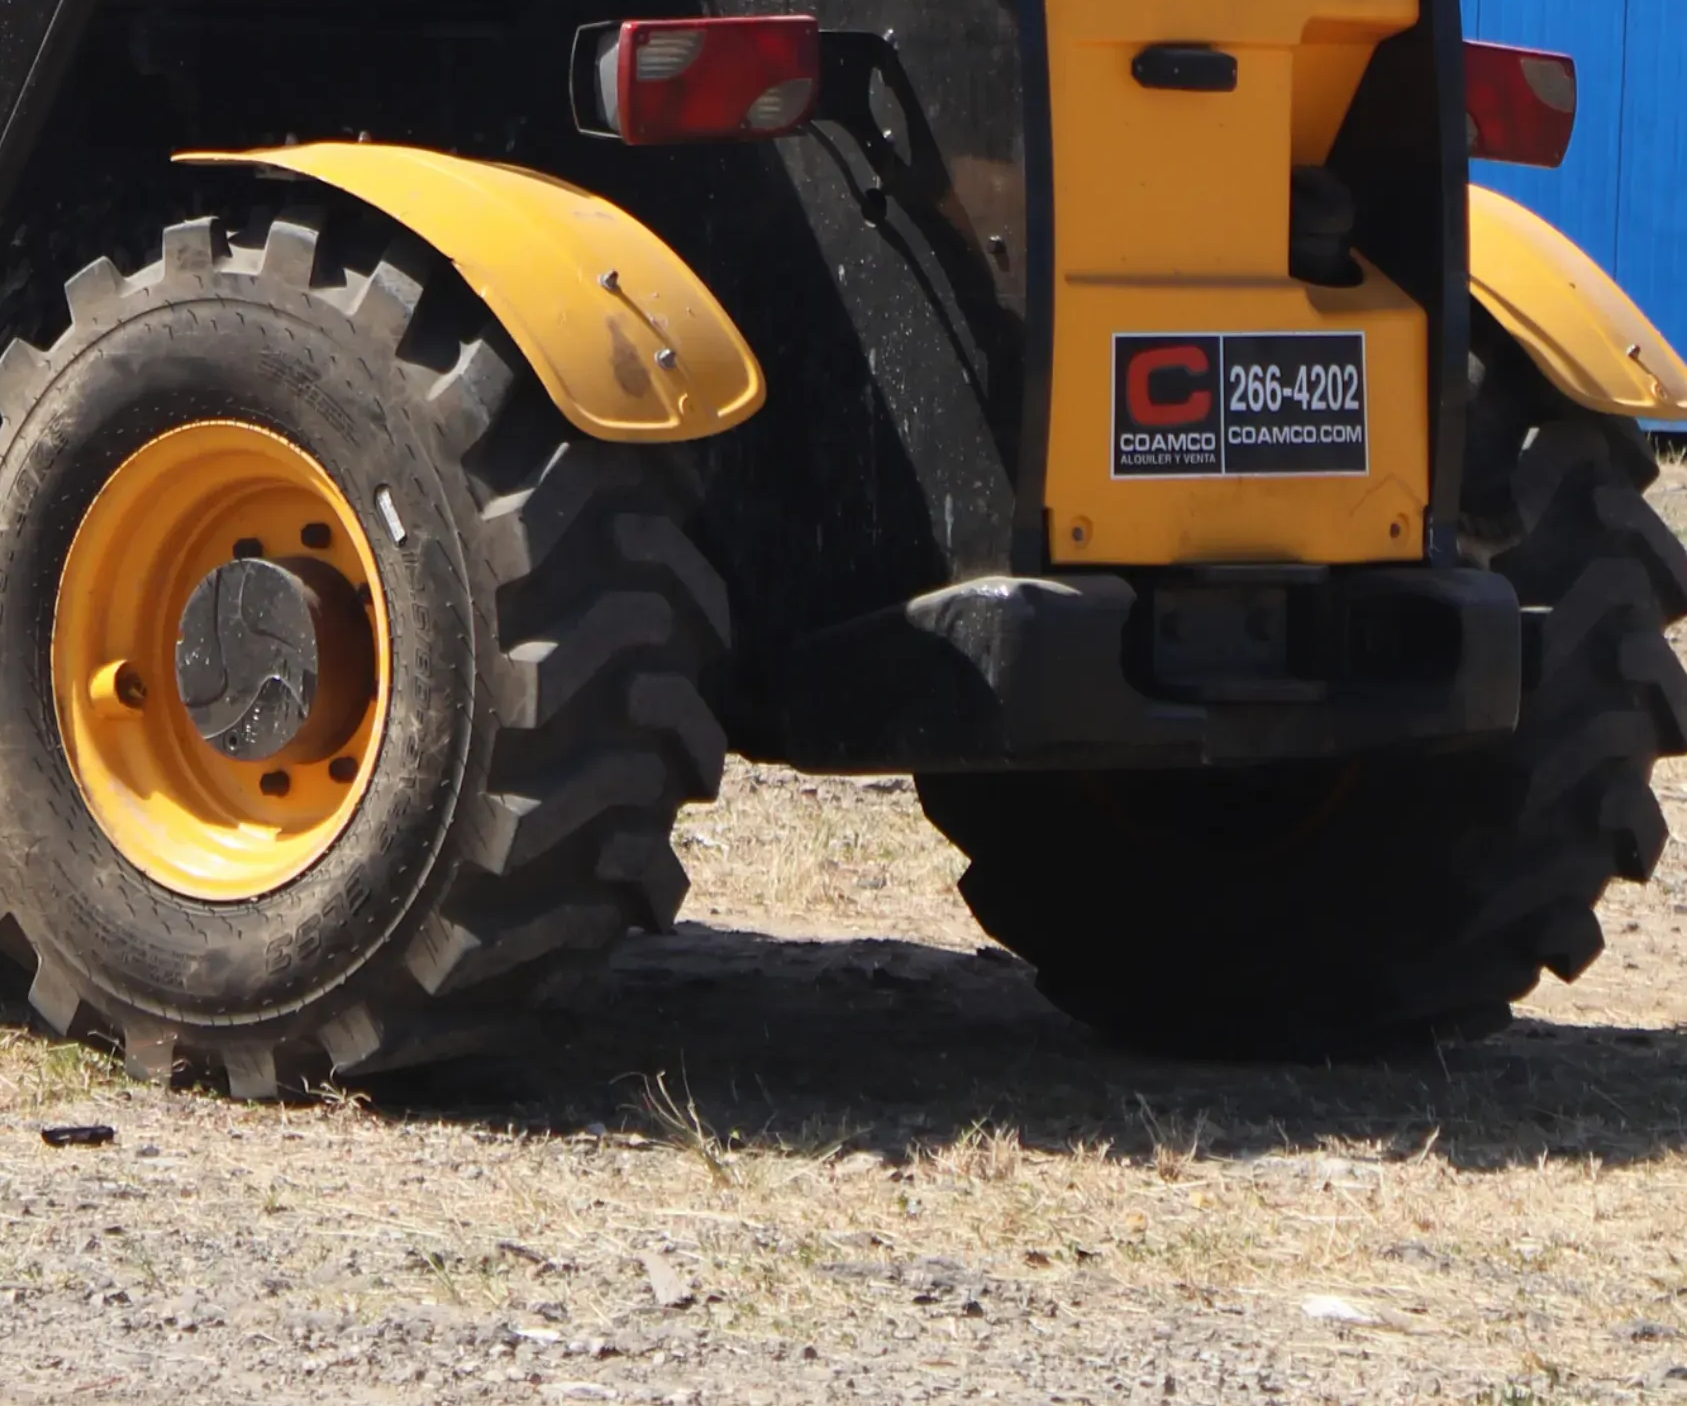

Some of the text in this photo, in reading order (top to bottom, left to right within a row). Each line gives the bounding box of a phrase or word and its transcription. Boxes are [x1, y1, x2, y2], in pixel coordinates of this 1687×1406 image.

[1126, 344, 1211, 426] C
[1228, 364, 1360, 412] 266-4202
[1119, 432, 1217, 452] COAMCO
[1227, 425, 1363, 445] COAMCO.COM
[1120, 452, 1217, 465] ALQUILER Y VENTA
